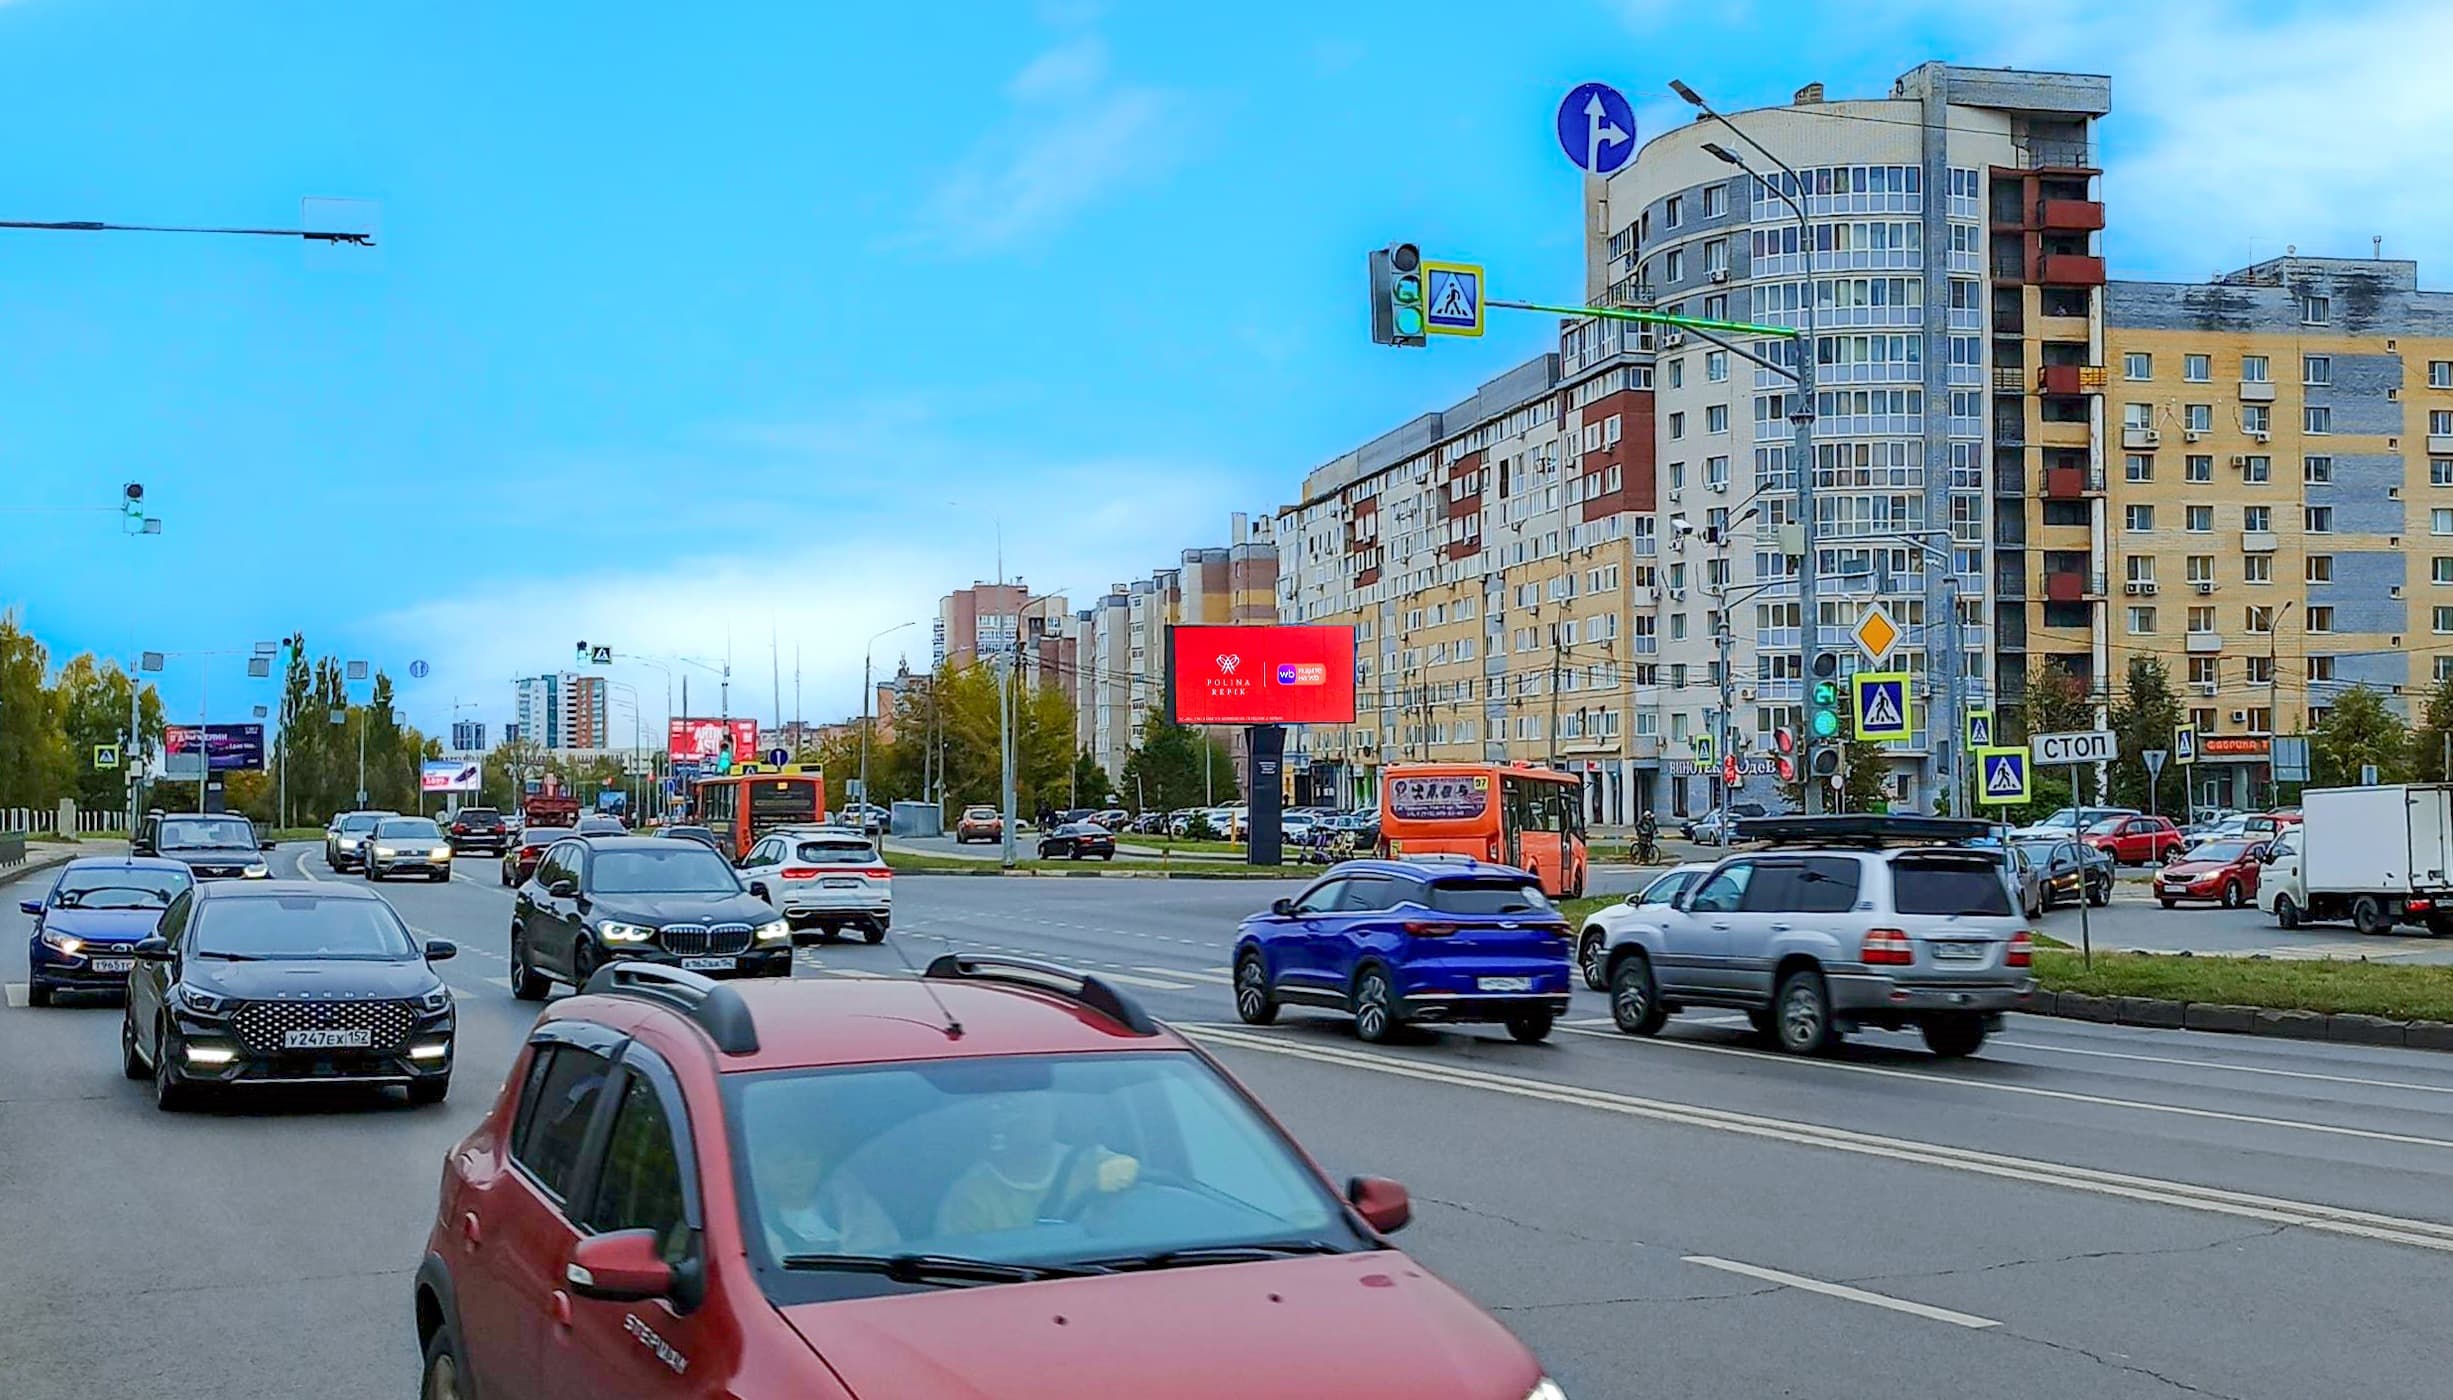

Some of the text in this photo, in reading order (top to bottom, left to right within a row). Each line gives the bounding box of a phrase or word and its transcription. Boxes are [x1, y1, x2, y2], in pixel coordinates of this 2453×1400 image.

[1206, 679, 1251, 687] POLINA
[1211, 688, 1246, 696] REPIK
[2044, 736, 2106, 758] СТОП
[1669, 761, 1724, 774] ВИНОТЕК
[289, 1031, 369, 1045] У247ЕХ 152
